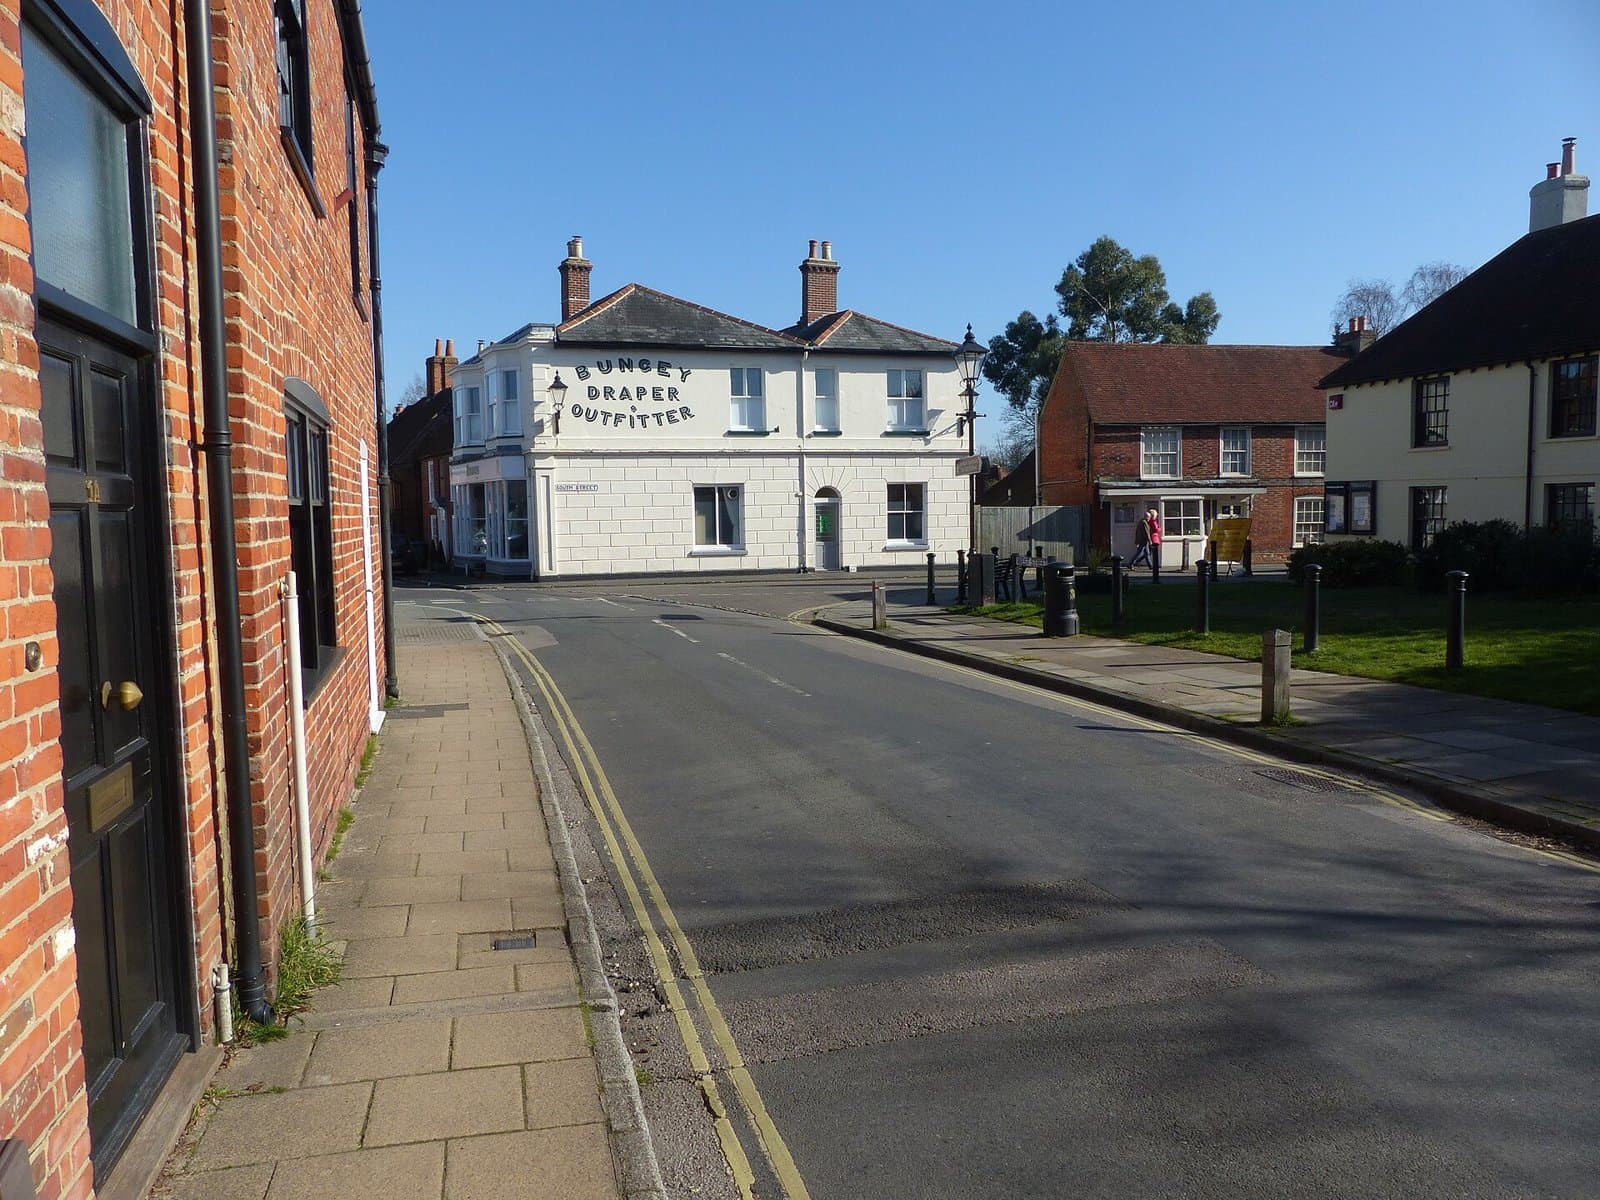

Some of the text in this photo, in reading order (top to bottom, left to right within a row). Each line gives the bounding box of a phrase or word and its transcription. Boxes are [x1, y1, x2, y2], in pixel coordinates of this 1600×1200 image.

[587, 386, 680, 401] DRAPER
[571, 404, 695, 428] OUTFITTER
[575, 483, 597, 491] STREET
